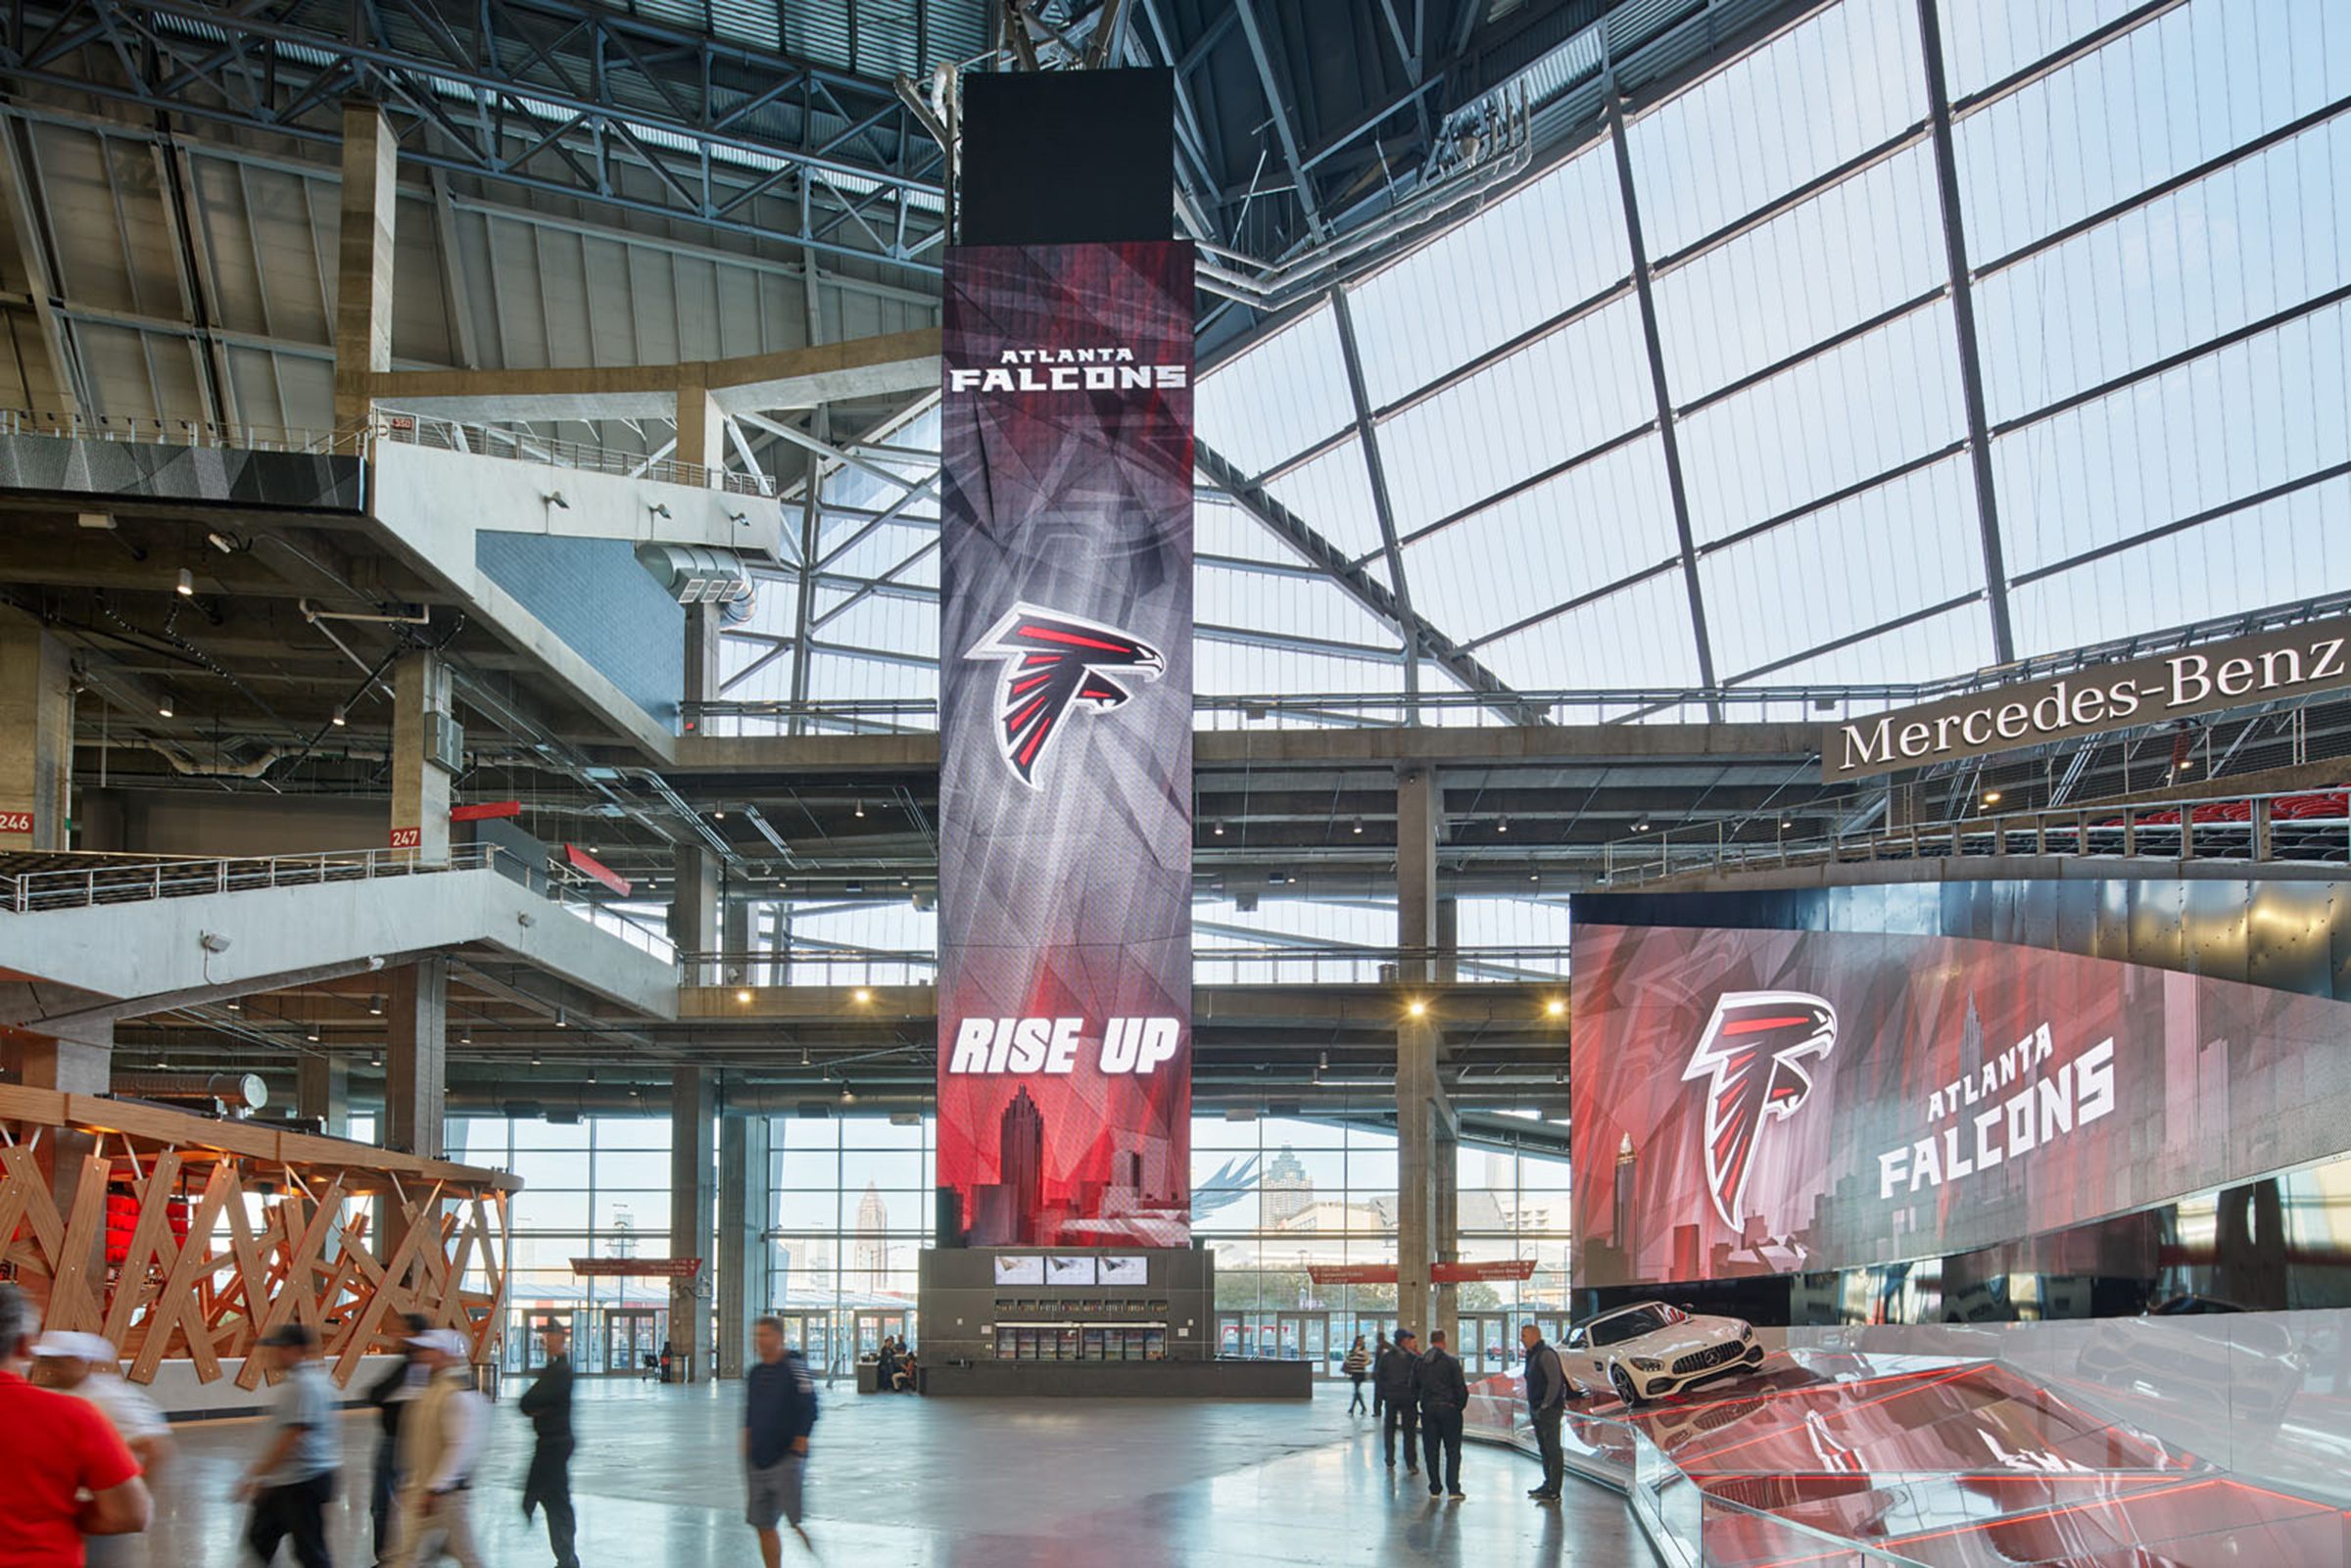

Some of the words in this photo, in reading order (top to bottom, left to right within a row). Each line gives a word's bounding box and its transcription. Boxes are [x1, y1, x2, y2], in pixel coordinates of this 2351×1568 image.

[1000, 348, 1134, 364] ATLANTA
[950, 364, 1187, 393] FALCONS
[1839, 637, 2346, 772] Mercedes-Benz
[0, 815, 29, 831] 246
[393, 830, 418, 846] 247
[948, 1017, 1084, 1074] RISE
[1099, 1017, 1180, 1074] UP
[1927, 1021, 2054, 1123] ATLANTA
[1877, 1035, 2116, 1200] FALCONS
